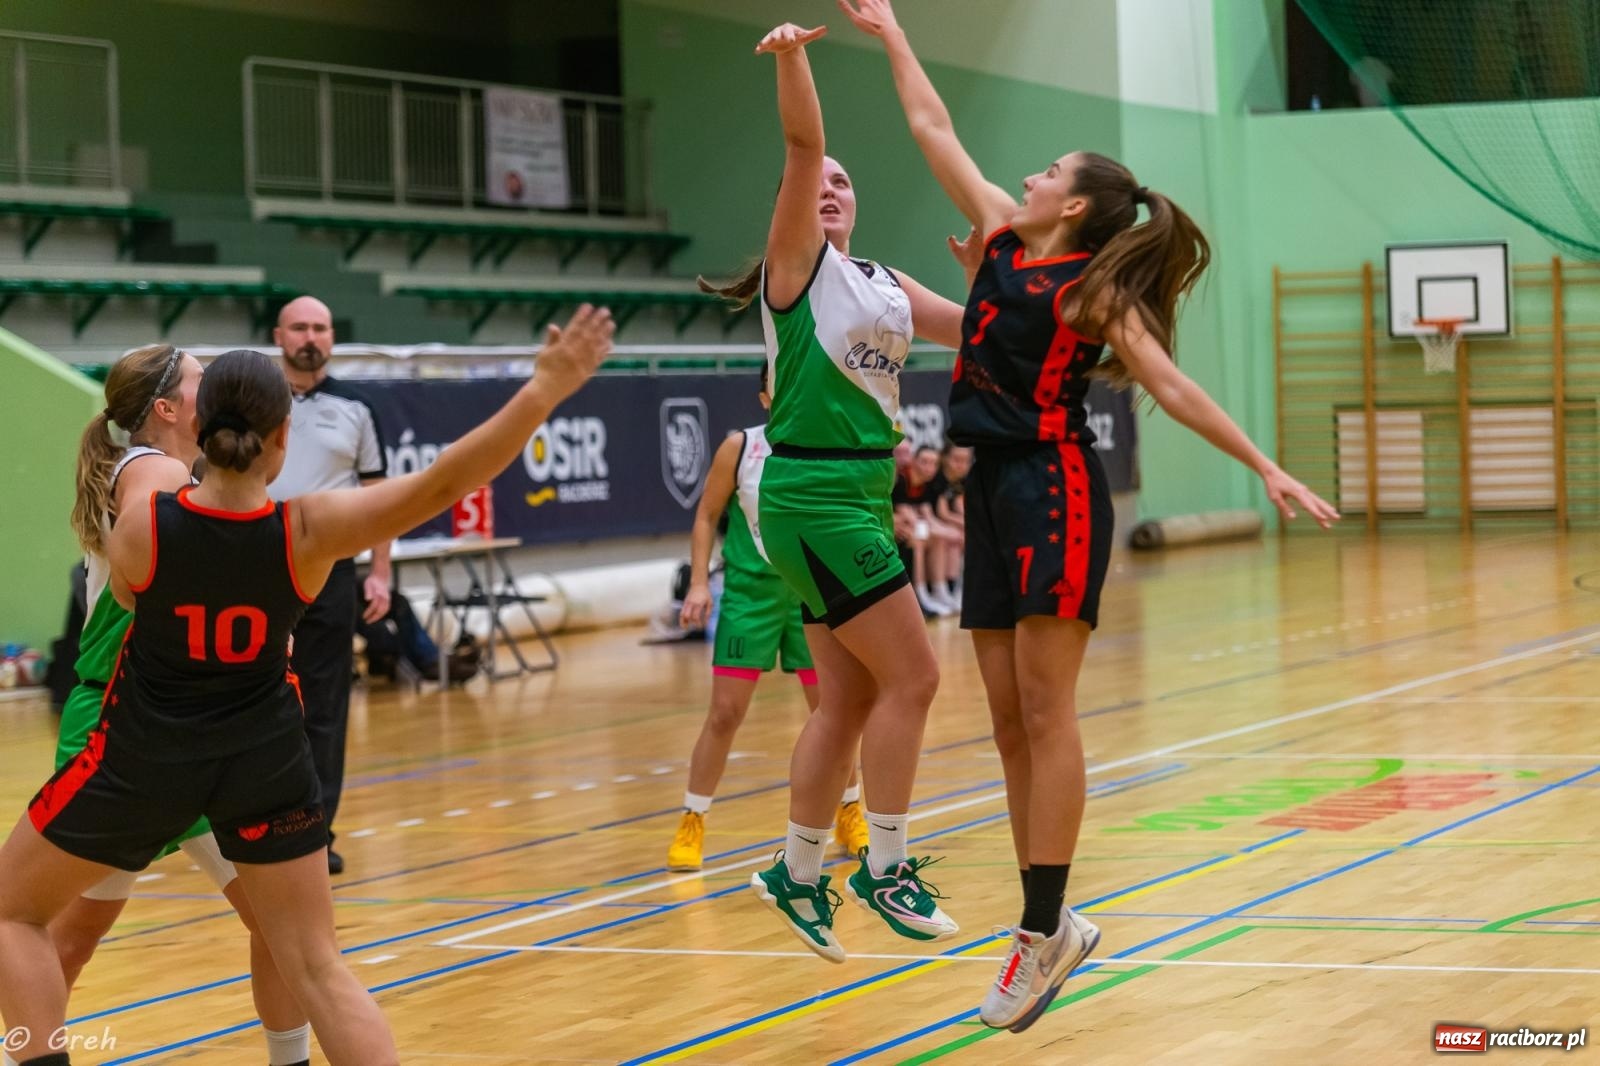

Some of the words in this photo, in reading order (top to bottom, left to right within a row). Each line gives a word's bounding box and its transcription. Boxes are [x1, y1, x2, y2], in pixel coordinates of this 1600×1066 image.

[969, 299, 999, 345] 7
[1016, 546, 1035, 596] 7
[174, 604, 268, 664] 10
